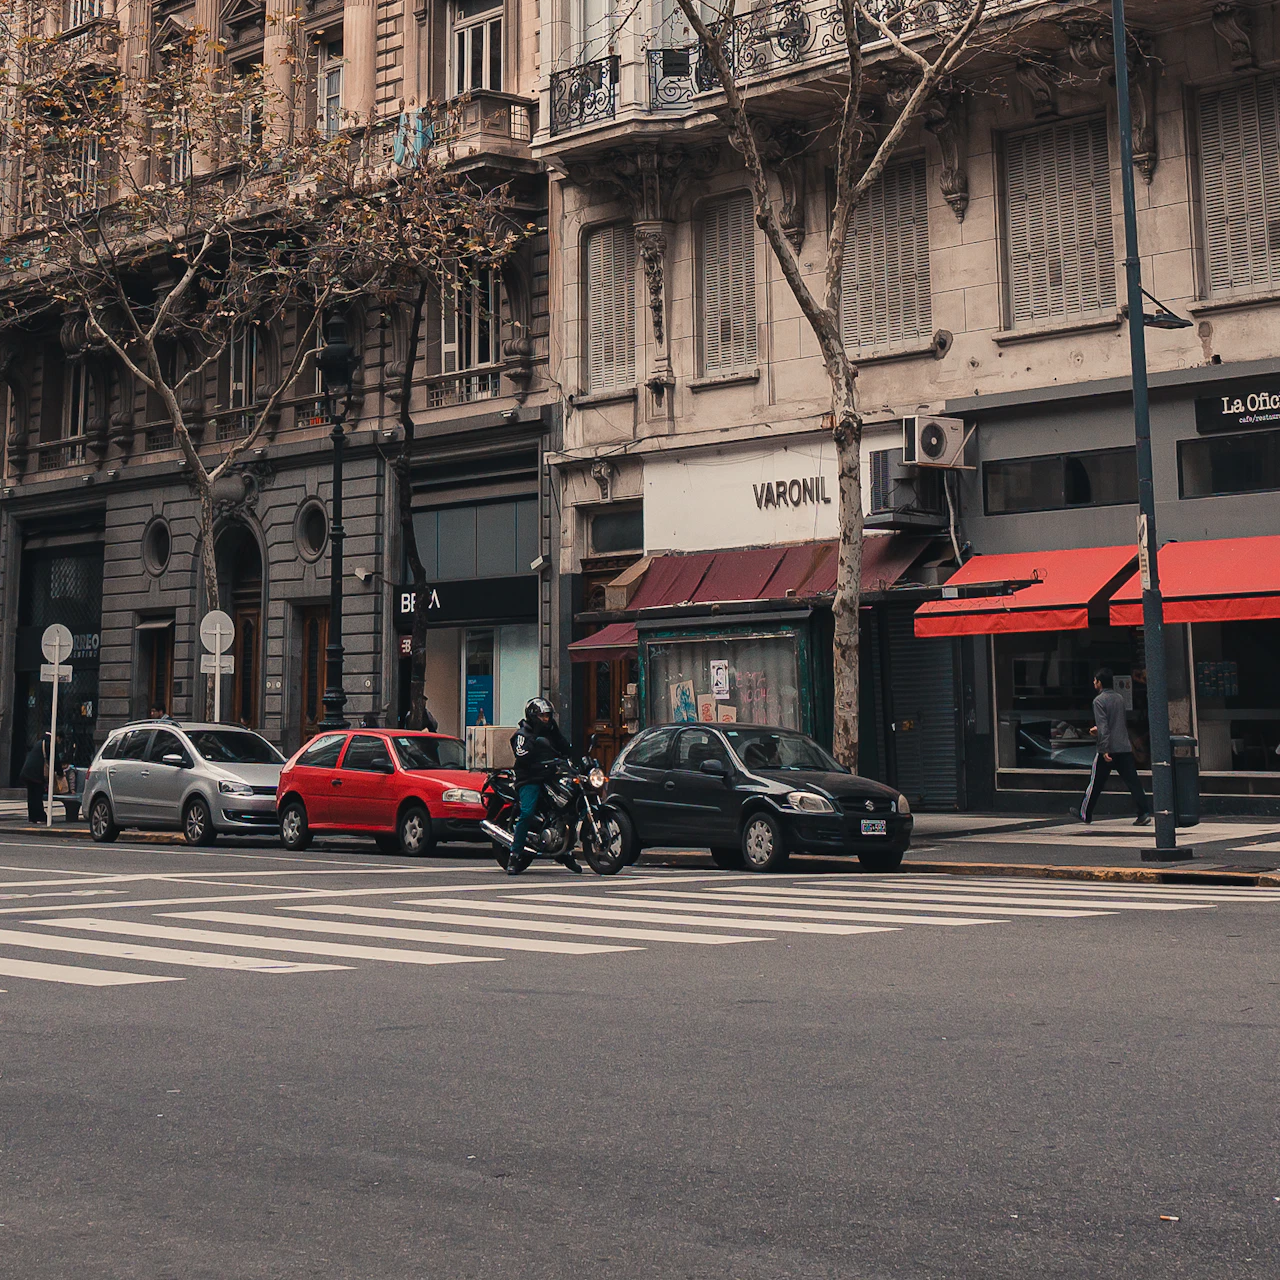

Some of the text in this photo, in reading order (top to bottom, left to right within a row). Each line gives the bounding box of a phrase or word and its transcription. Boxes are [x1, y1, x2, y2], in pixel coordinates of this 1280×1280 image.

[1221, 397, 1245, 414] La
[752, 476, 832, 510] VARONIL
[401, 589, 440, 613] BA
[73, 633, 99, 650] RREO
